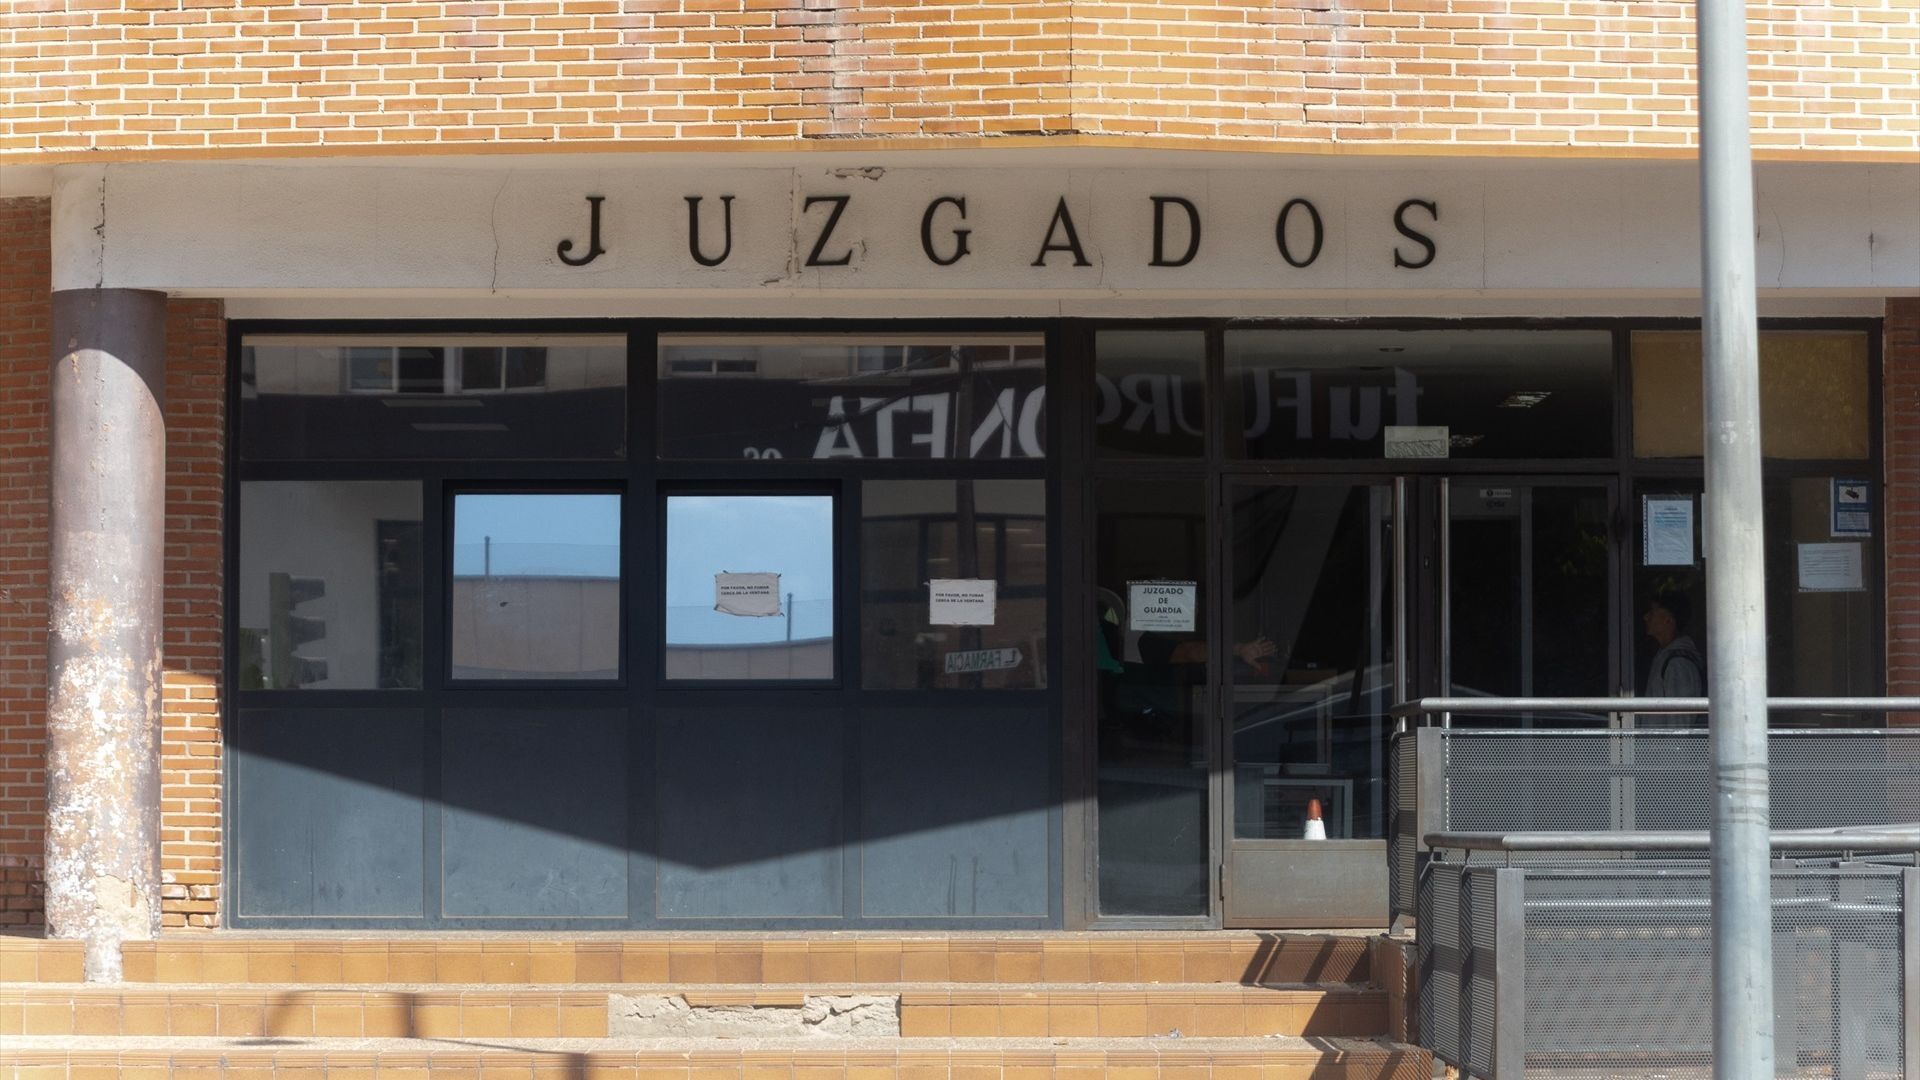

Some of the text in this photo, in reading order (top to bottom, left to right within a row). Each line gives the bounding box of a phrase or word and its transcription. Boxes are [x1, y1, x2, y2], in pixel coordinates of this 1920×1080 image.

[556, 195, 1440, 270] JUZGADOS
[1143, 587, 1184, 595] JUZGADO
[1143, 606, 1183, 614] GUARDIA
